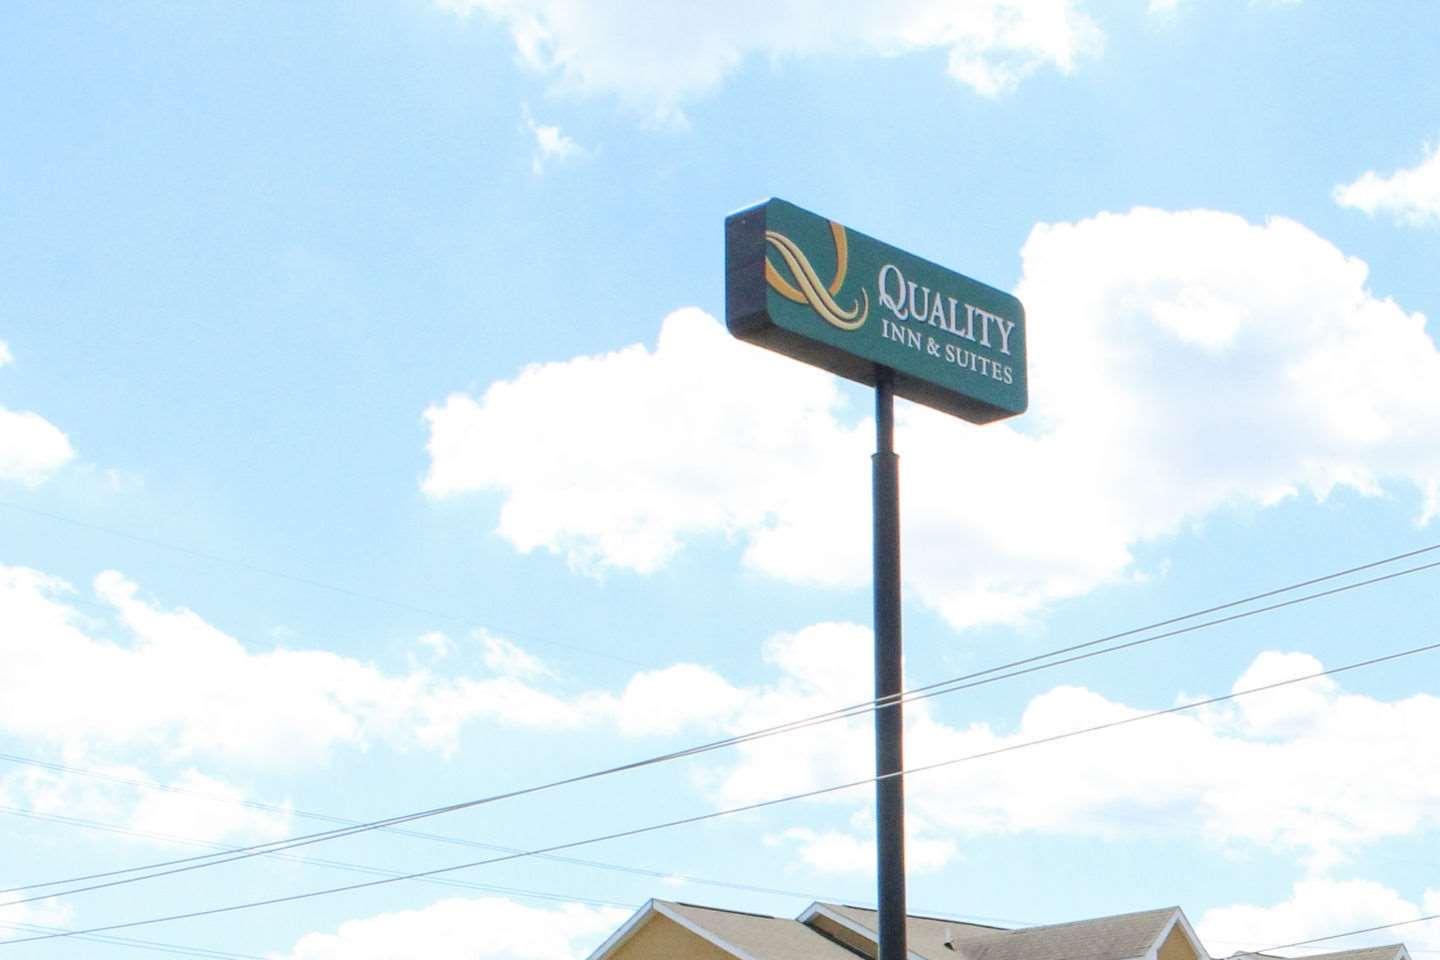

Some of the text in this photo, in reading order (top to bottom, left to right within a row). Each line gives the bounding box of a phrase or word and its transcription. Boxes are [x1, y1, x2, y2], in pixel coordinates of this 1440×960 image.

[878, 264, 1015, 356] QUALITY
[881, 318, 1013, 385] INN & SUITES
